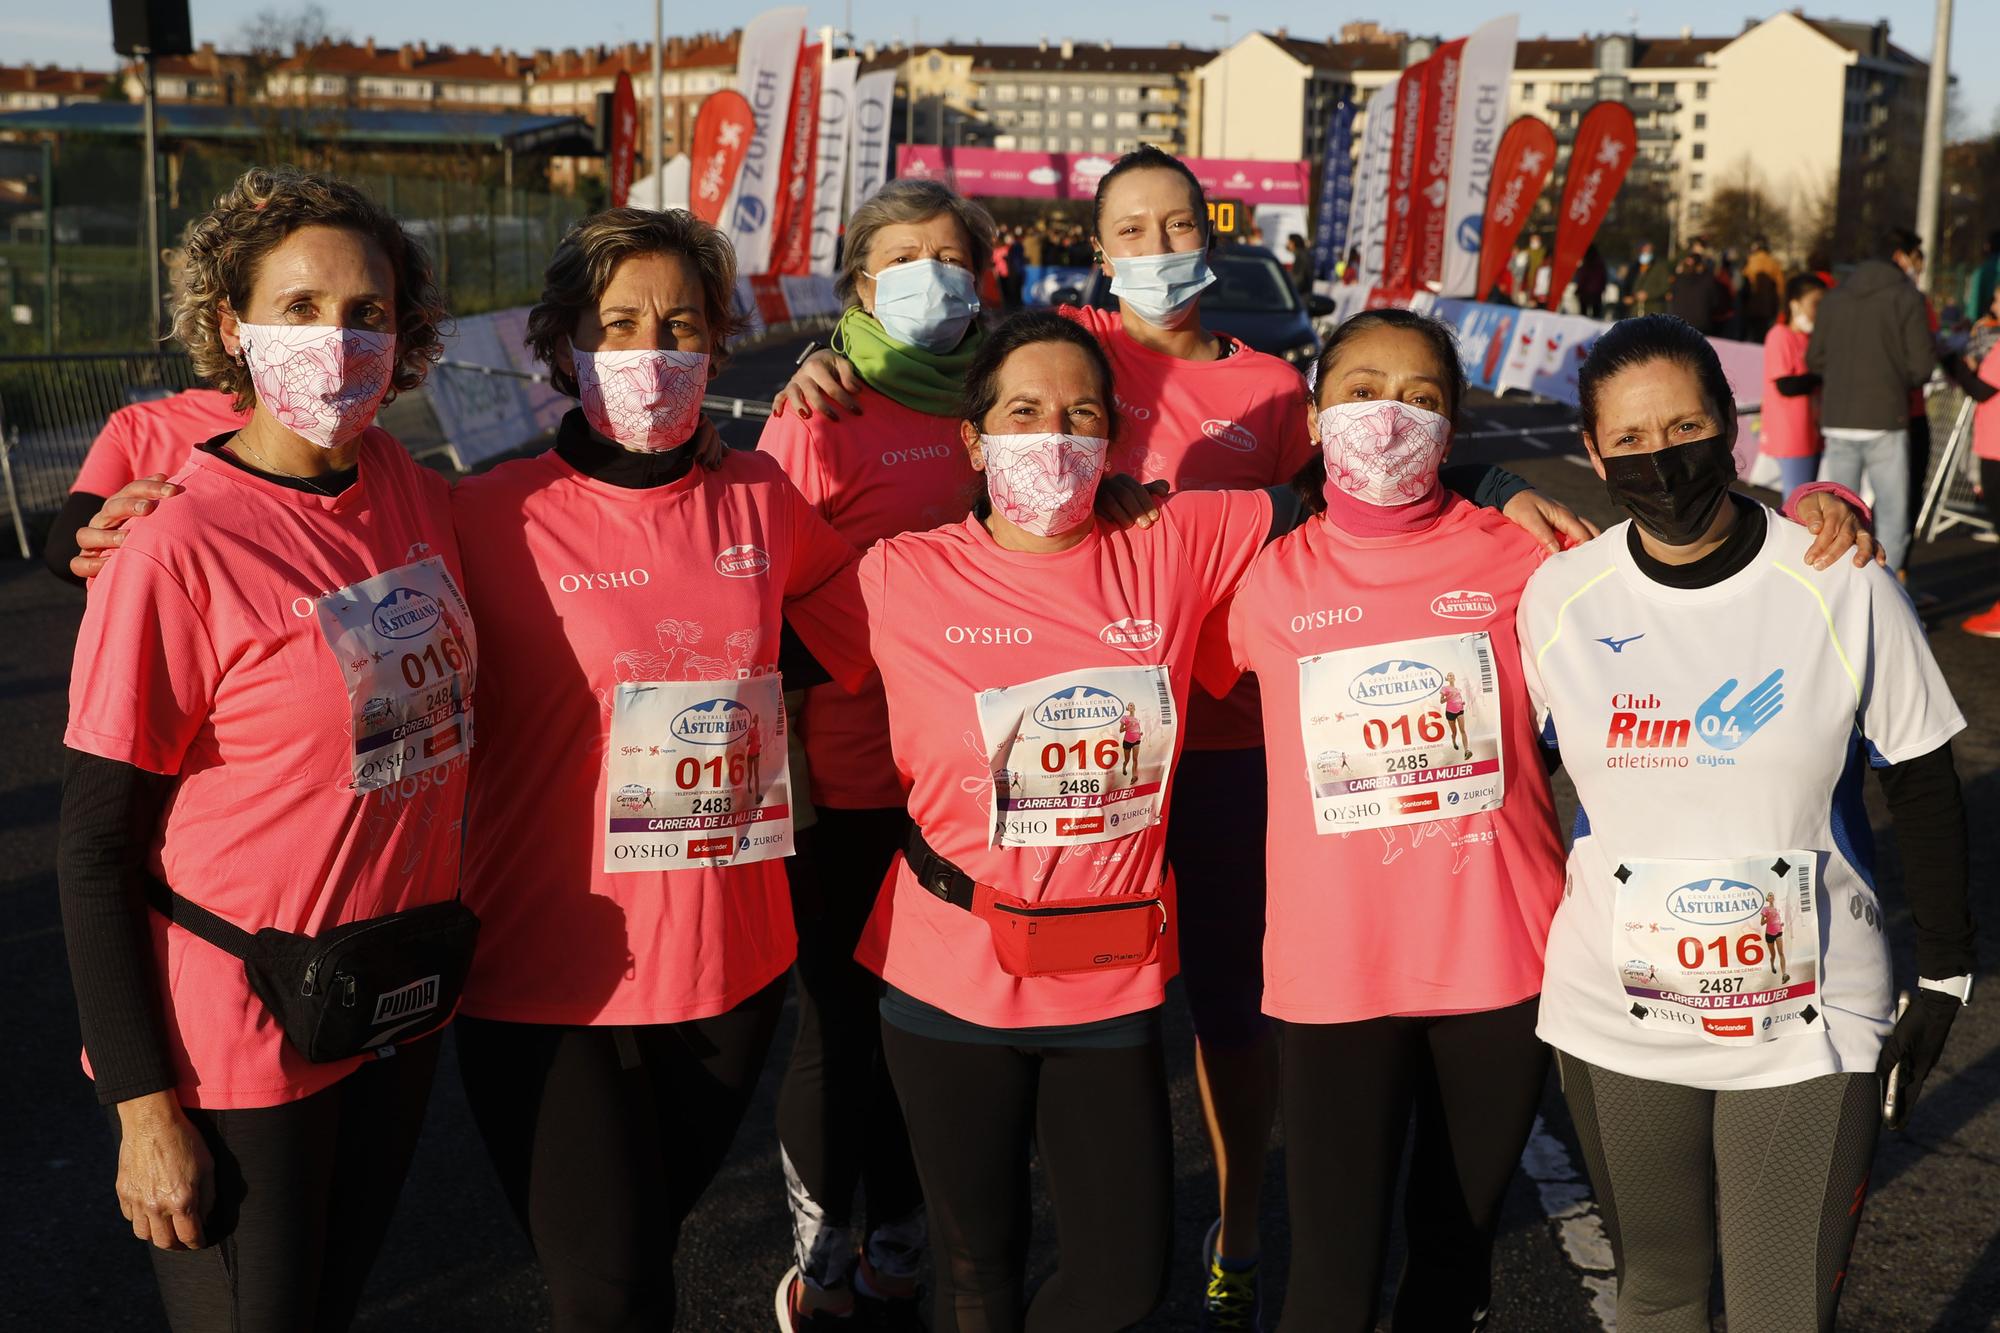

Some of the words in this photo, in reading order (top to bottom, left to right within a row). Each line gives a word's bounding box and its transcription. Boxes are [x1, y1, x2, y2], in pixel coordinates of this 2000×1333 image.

[745, 70, 778, 184] ZURICH
[1429, 58, 1459, 177] Santander
[1468, 84, 1498, 202] ZURICH
[1113, 393, 1150, 421] SHO
[881, 444, 951, 466] OYSHO
[559, 568, 650, 593] OYSHO
[1437, 601, 1493, 614] ASTURIANA
[378, 603, 438, 635] ASTURIANA
[1290, 605, 1363, 633] OYSHO
[945, 625, 1033, 645] OYSHO
[1105, 630, 1159, 645] ASTURIANA
[400, 637, 464, 689] 016
[1355, 677, 1437, 700] ASTURIANA
[1612, 693, 1661, 709] Club
[392, 712, 435, 740] CARRERA
[436, 702, 450, 722] DE
[1040, 705, 1119, 722] ASTURIANA
[676, 716, 749, 735] ASTURIANA
[1362, 710, 1446, 750] 016
[1606, 712, 1691, 749] Run
[1700, 715, 1742, 743] 04
[361, 745, 416, 779] OYSHO
[1041, 739, 1121, 773] 016
[1385, 753, 1429, 773] 2485
[1606, 752, 1689, 768] atletismo
[1696, 754, 1736, 767] Gijón
[675, 753, 746, 790] 016
[1349, 776, 1398, 792] CARRERA
[1400, 773, 1416, 785] DE
[1417, 770, 1434, 782] LA
[1435, 765, 1473, 781] MUJER
[1059, 779, 1100, 795] 2486
[691, 797, 732, 815] 2483
[1017, 796, 1068, 809] CARRERA
[1071, 796, 1087, 807] DE
[1088, 795, 1103, 806] LA
[1401, 798, 1433, 809] Santander
[1463, 788, 1494, 800] ZURICH
[648, 815, 701, 831] CARRERA
[704, 815, 718, 828] DE
[719, 814, 733, 826] LA
[734, 809, 764, 826] MUJER
[1068, 821, 1099, 831] Santander
[1122, 809, 1150, 821] ZURICH
[1323, 802, 1381, 822] OYSHO
[614, 843, 680, 860] OYSHO
[700, 843, 728, 852] Santander
[753, 834, 784, 846] ZURICH
[1673, 895, 1759, 914] ASTURIANA
[1676, 933, 1765, 970] 016
[1699, 977, 1745, 994] 2487
[377, 979, 437, 1020] PUMA
[1659, 991, 1710, 1008] CARRERA
[1713, 996, 1731, 1008] DE
[1732, 994, 1750, 1006] LA
[1752, 988, 1789, 1005] MUJER
[1645, 1006, 1695, 1025] YSHO
[1714, 1023, 1748, 1032] Santander
[1774, 1012, 1801, 1024] ZURIC
